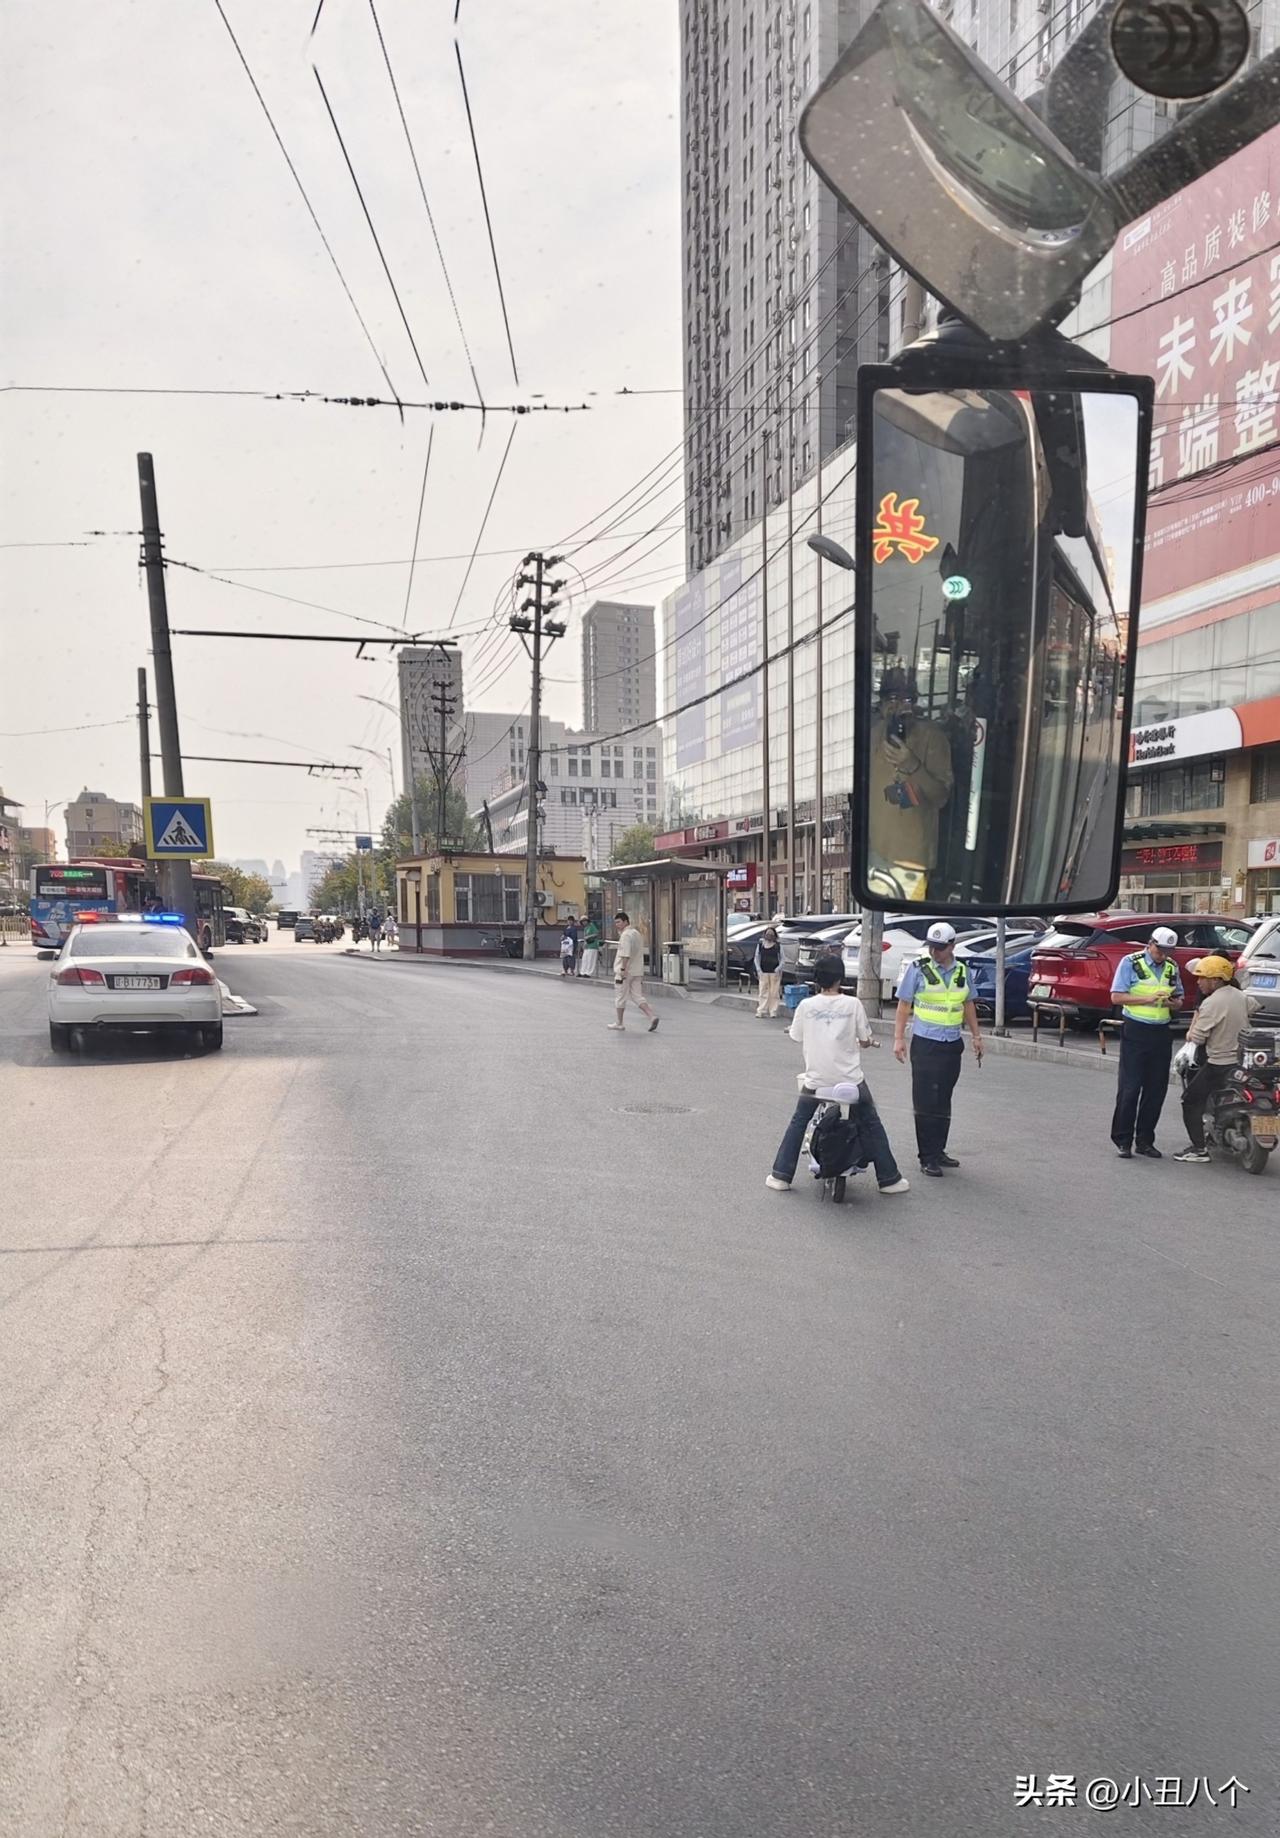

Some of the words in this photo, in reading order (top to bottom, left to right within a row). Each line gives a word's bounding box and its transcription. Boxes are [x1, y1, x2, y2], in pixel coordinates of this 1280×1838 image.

[1161, 190, 1280, 298] 高品质装修
[1245, 476, 1280, 507] 400-9
